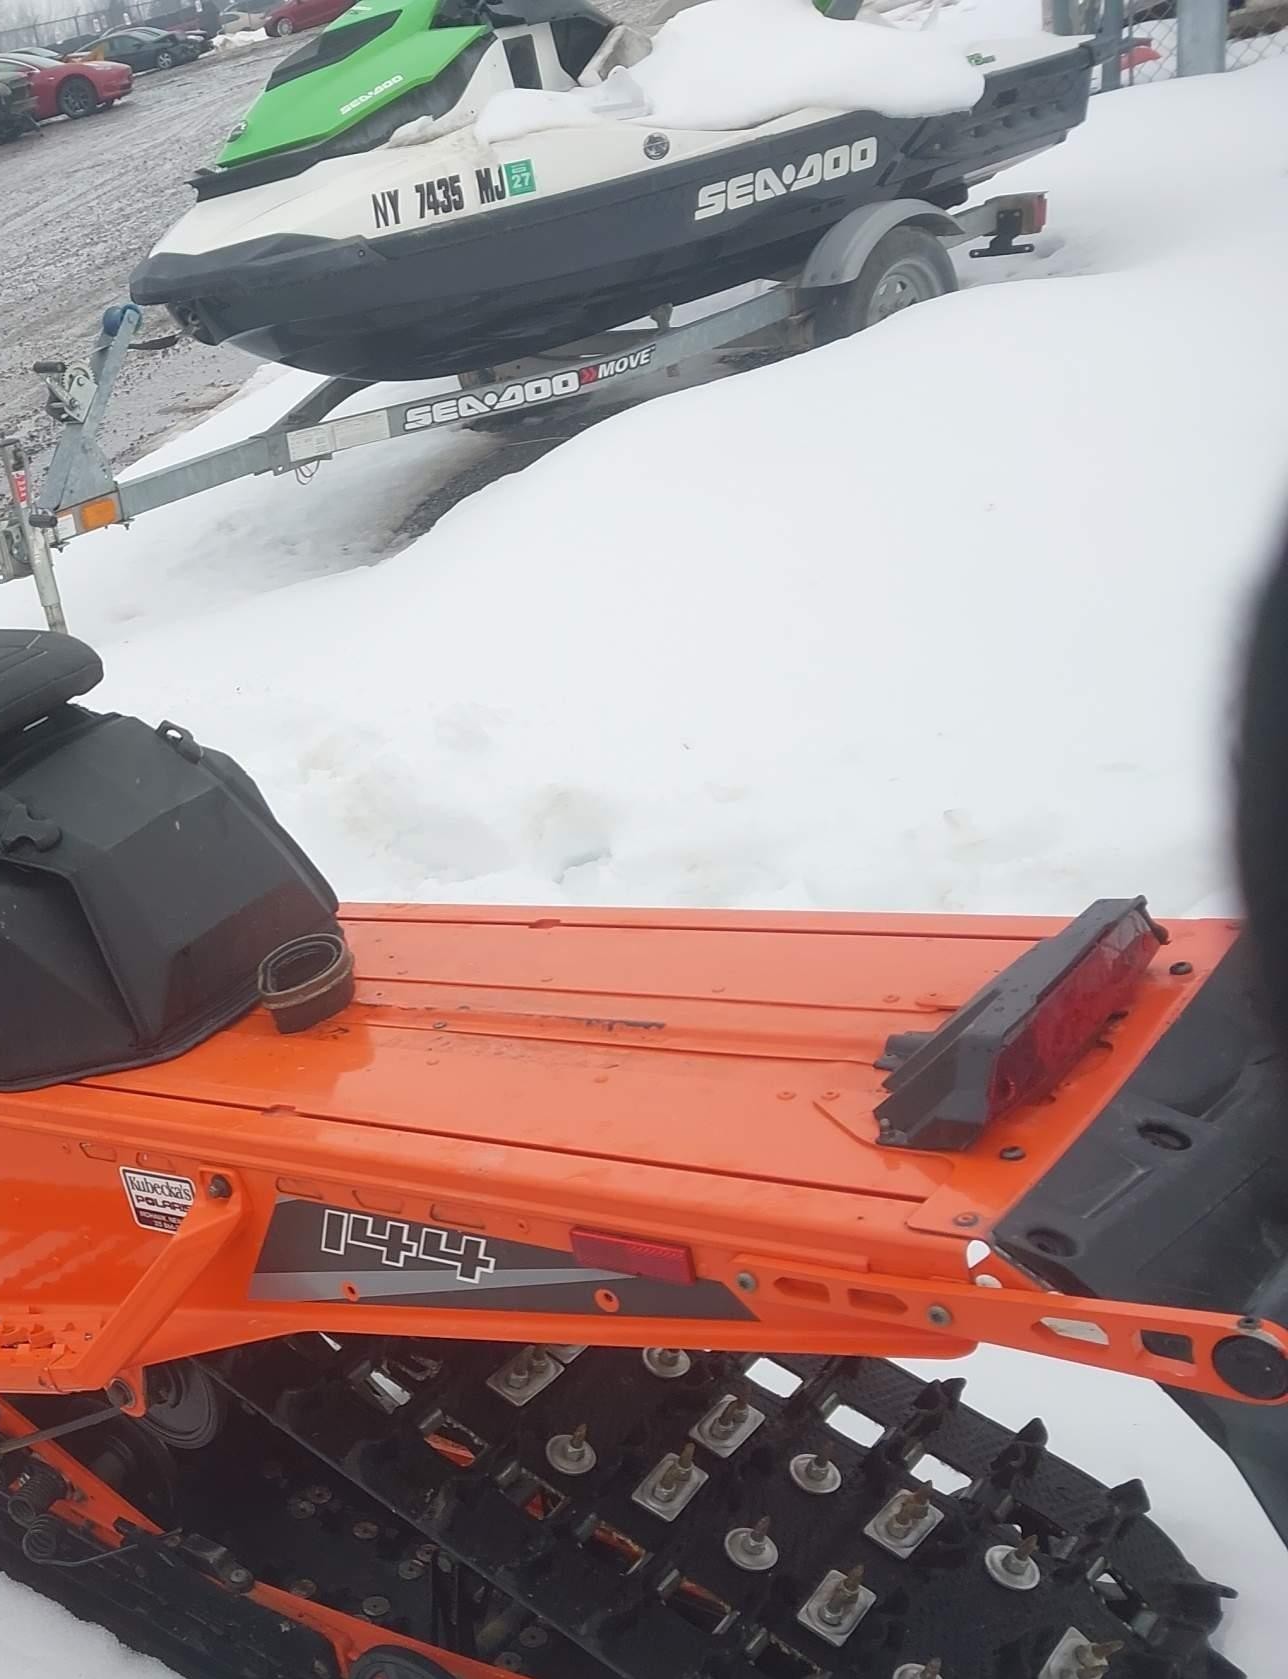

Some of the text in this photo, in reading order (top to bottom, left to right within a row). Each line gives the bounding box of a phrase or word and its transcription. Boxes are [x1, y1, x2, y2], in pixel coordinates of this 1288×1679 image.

[371, 164, 506, 228] NY 7435 MJ
[512, 172, 530, 189] 27
[597, 347, 652, 379] MOVE
[128, 1175, 192, 1202] Kubecka's
[320, 1208, 497, 1284] 144
